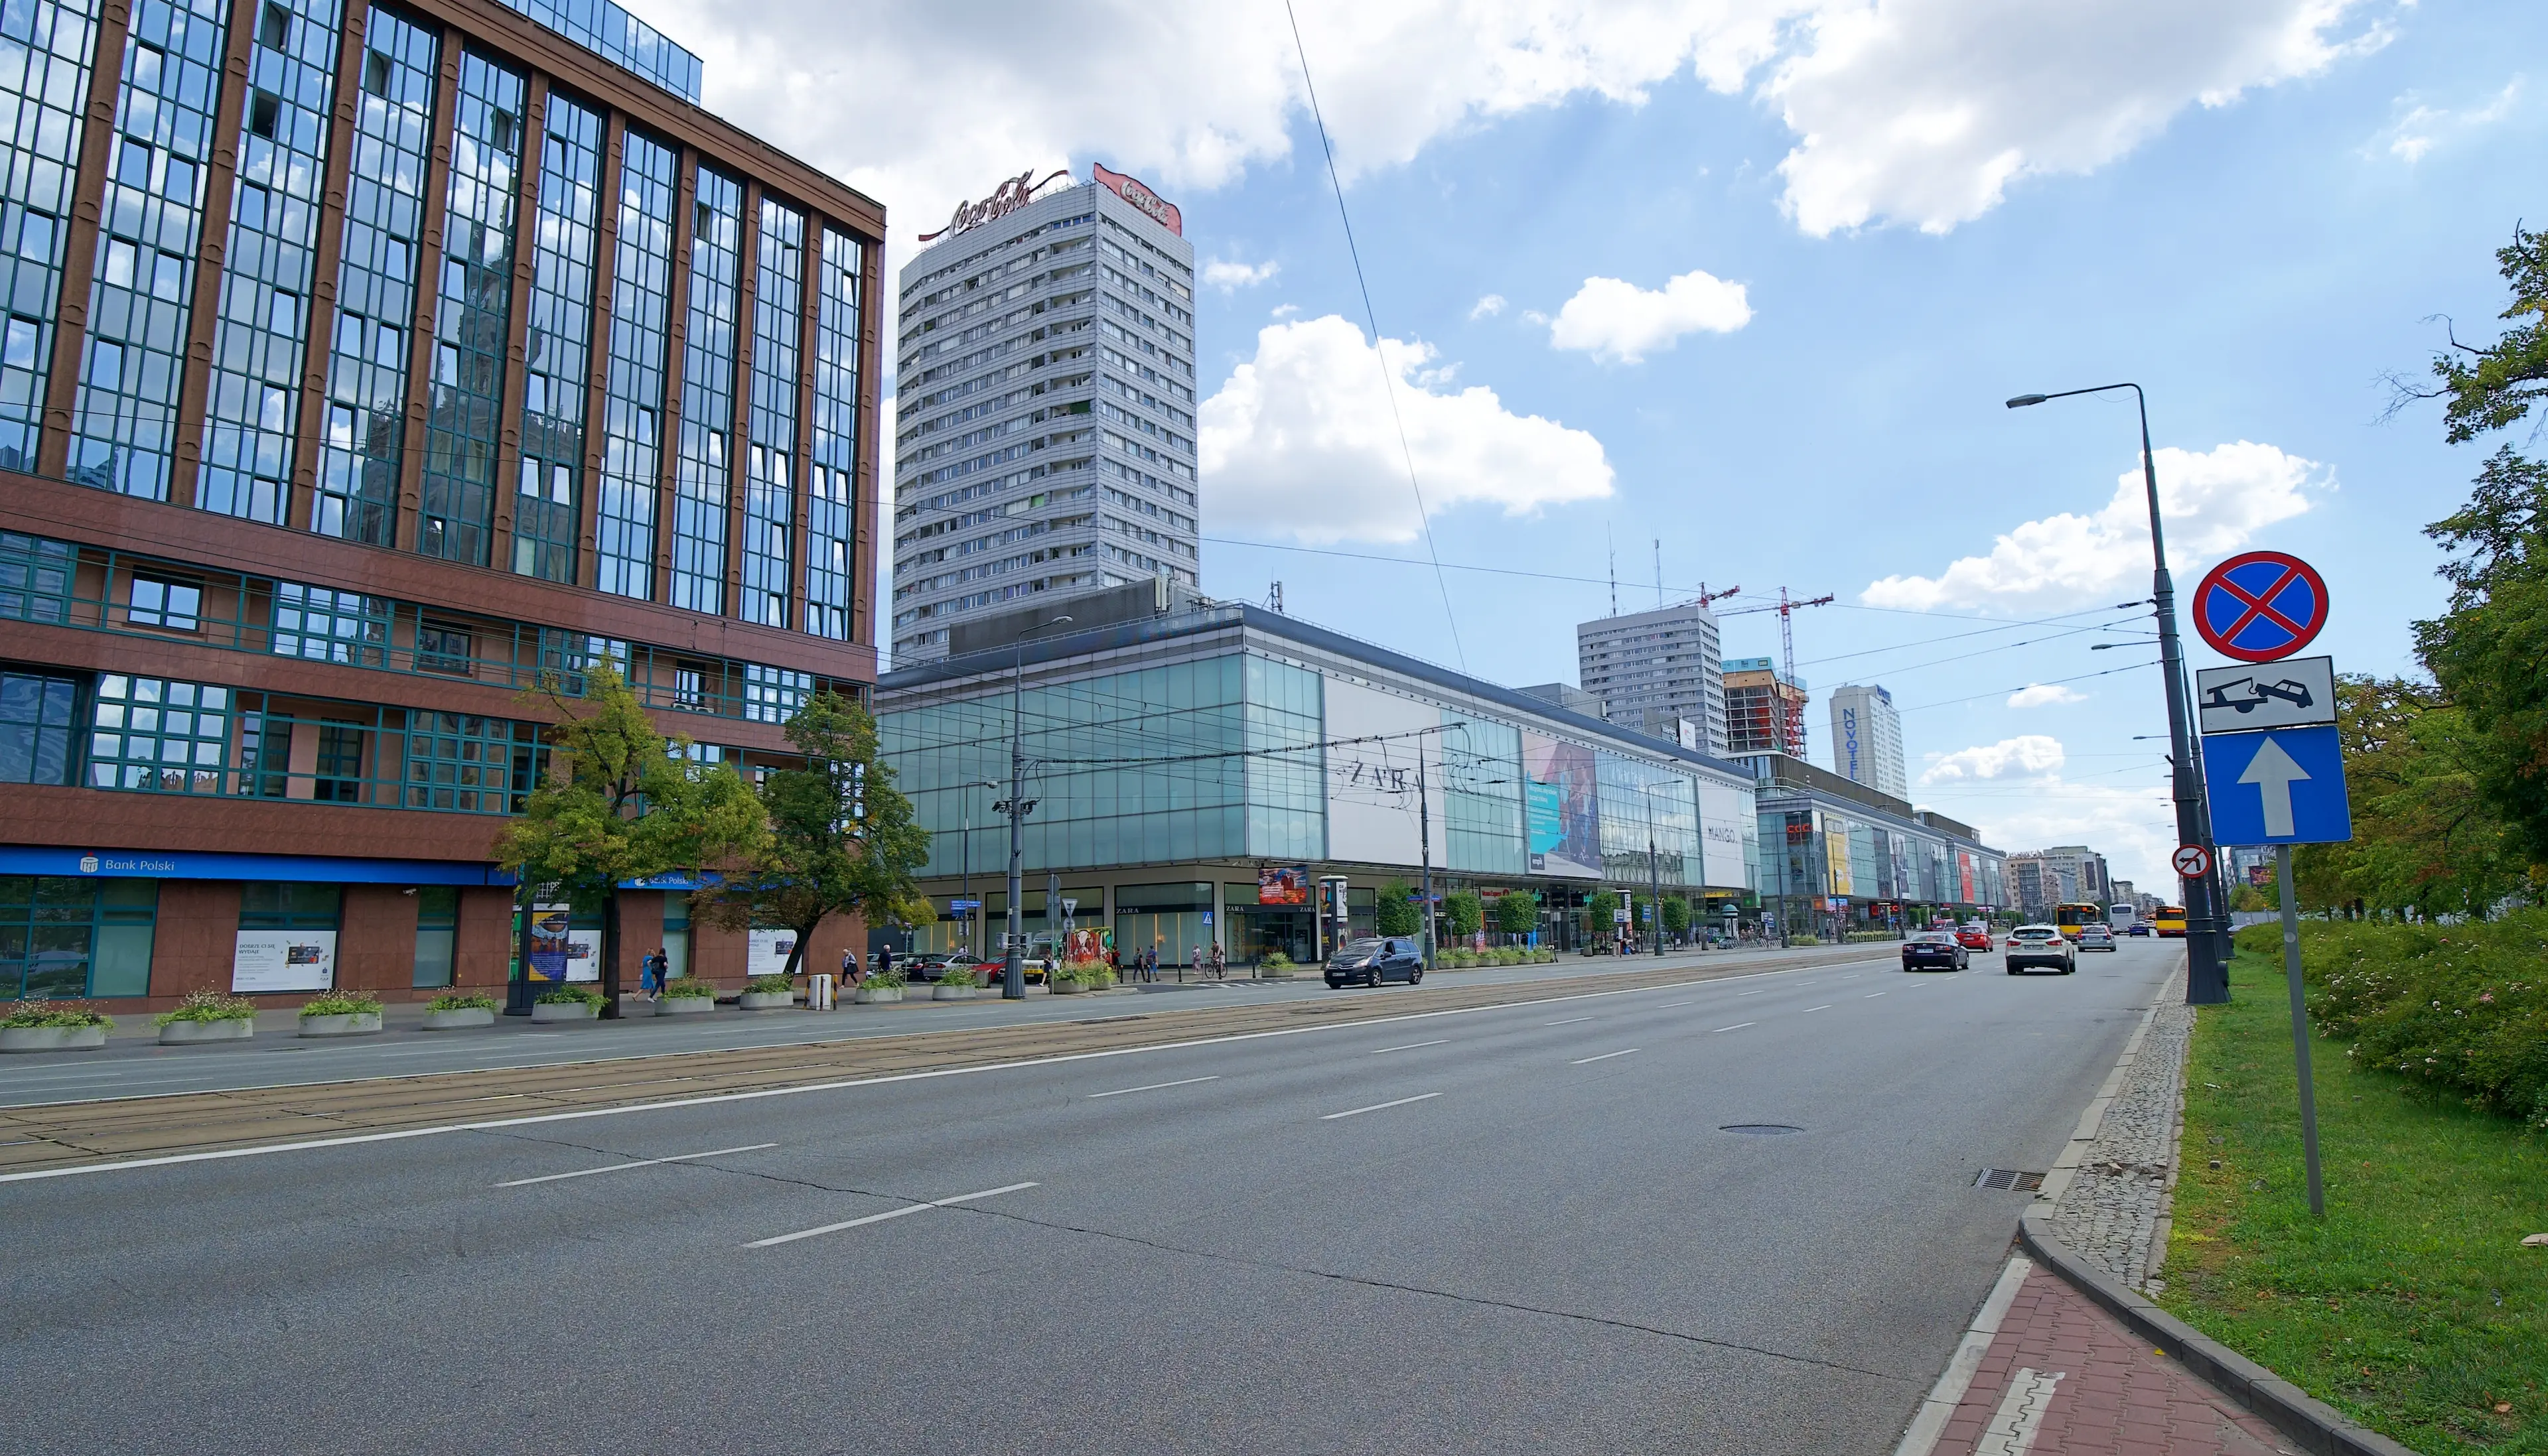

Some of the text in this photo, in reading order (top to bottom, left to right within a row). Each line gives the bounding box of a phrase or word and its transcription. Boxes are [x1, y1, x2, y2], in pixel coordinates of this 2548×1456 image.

[1843, 708, 1859, 781] NOVOTEL
[1351, 761, 1422, 793] ZARA
[1708, 825, 1735, 843] MANGO
[106, 860, 135, 870] Bank
[140, 860, 175, 871] Polski
